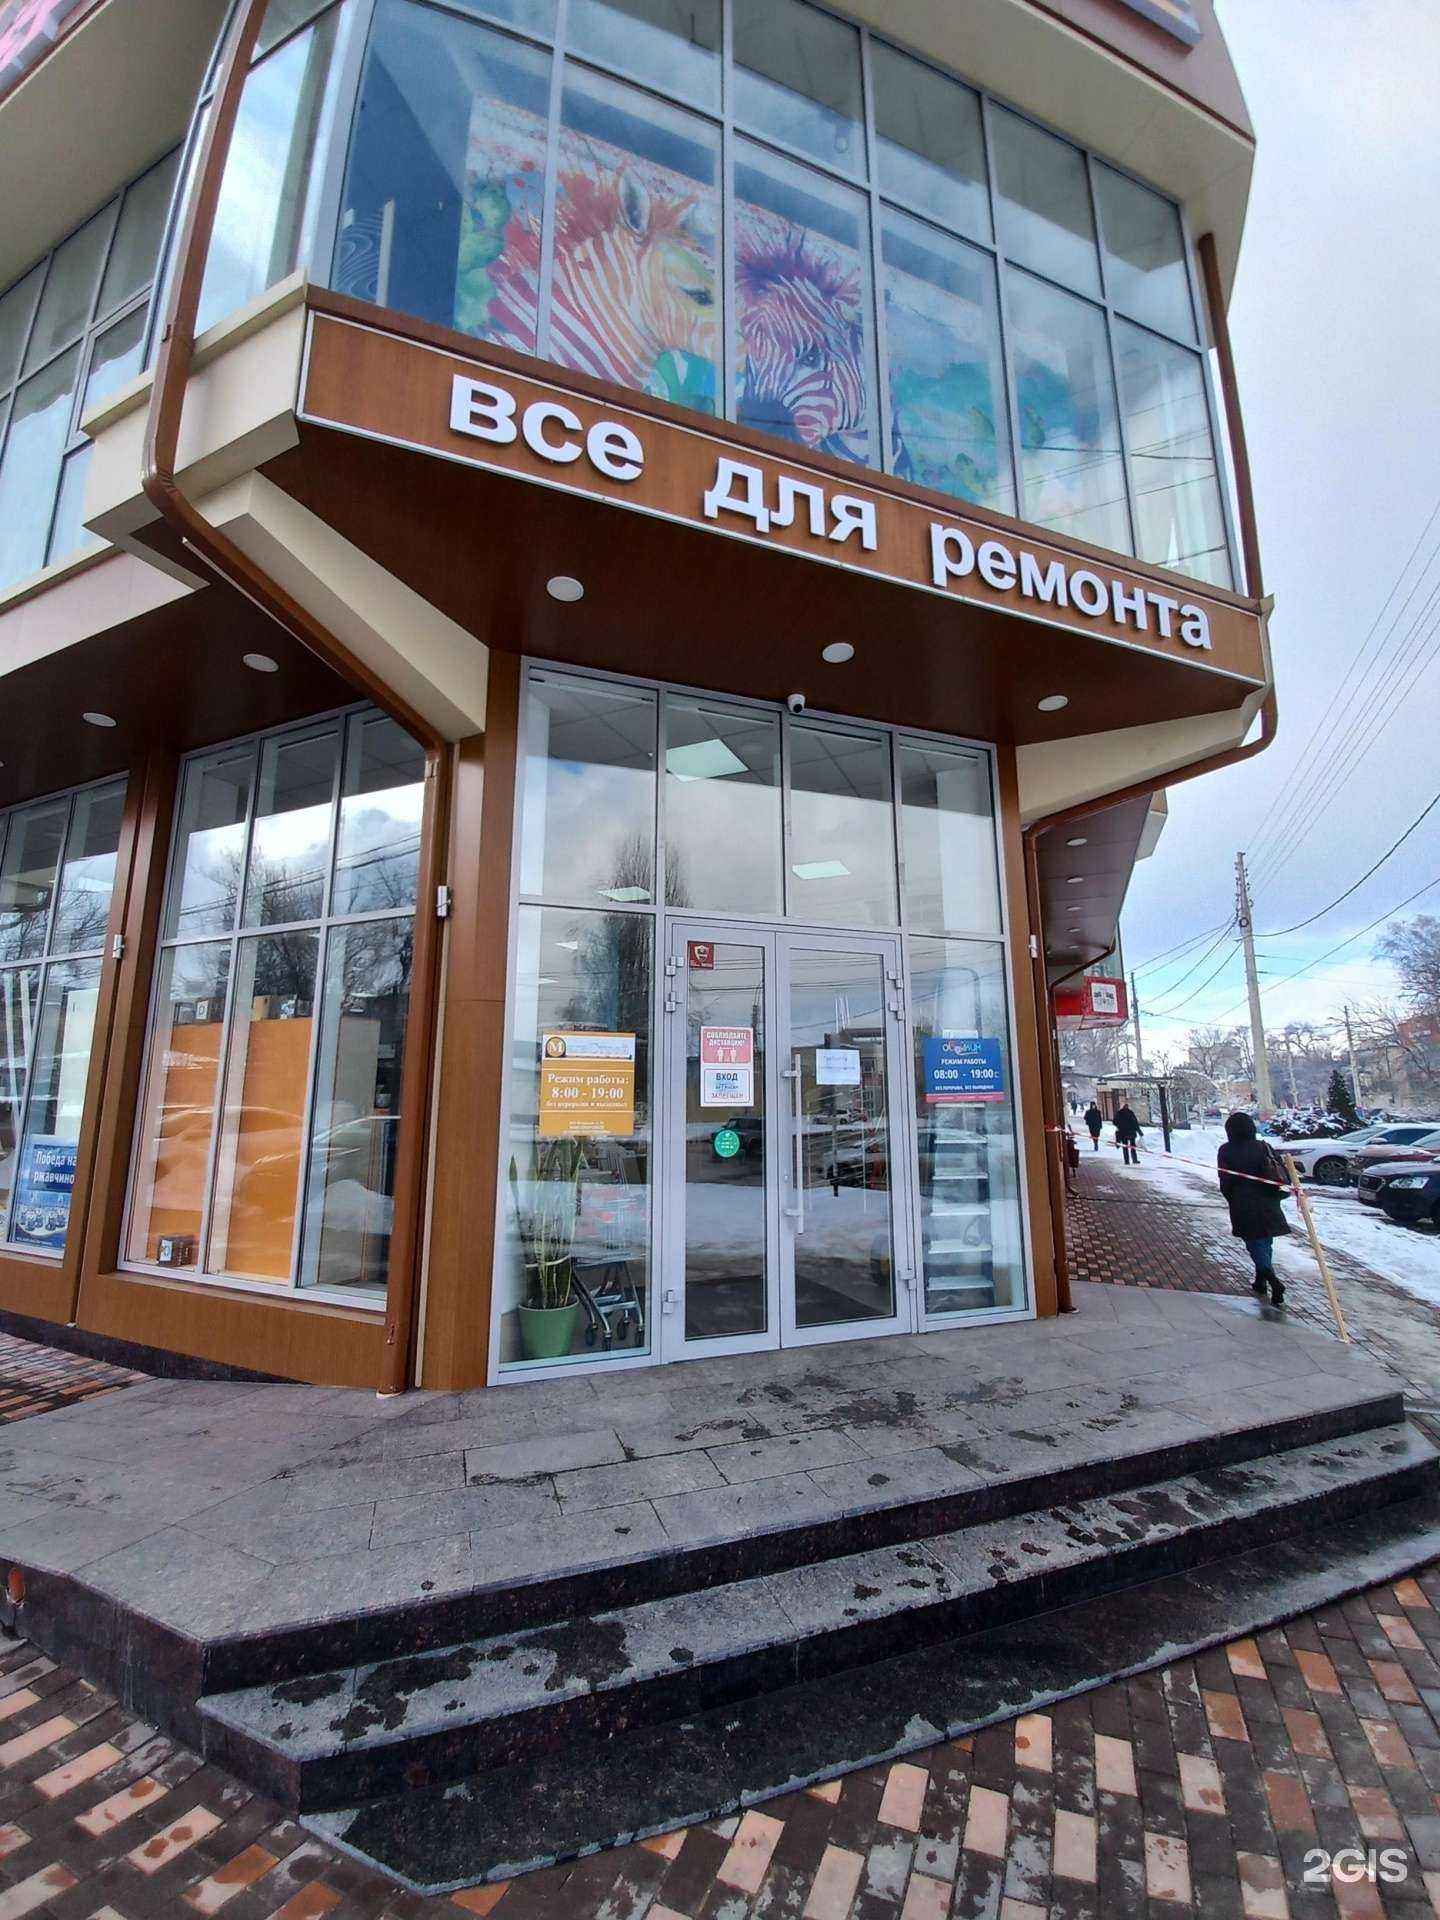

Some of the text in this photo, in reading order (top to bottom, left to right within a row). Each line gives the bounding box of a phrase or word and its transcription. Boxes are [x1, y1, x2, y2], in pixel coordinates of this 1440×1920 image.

[704, 456, 878, 552] для
[929, 522, 1213, 651] ремонта
[548, 1073, 629, 1086] Режим работы:
[715, 1073, 738, 1081] ВХОД
[933, 1069, 959, 1080] 08:00
[970, 1069, 994, 1079] 19:00
[551, 1087, 579, 1099] 8:00
[592, 1087, 624, 1099] 19:00
[35, 1151, 78, 1168] Победа на
[33, 1172, 75, 1185] ржавчино
